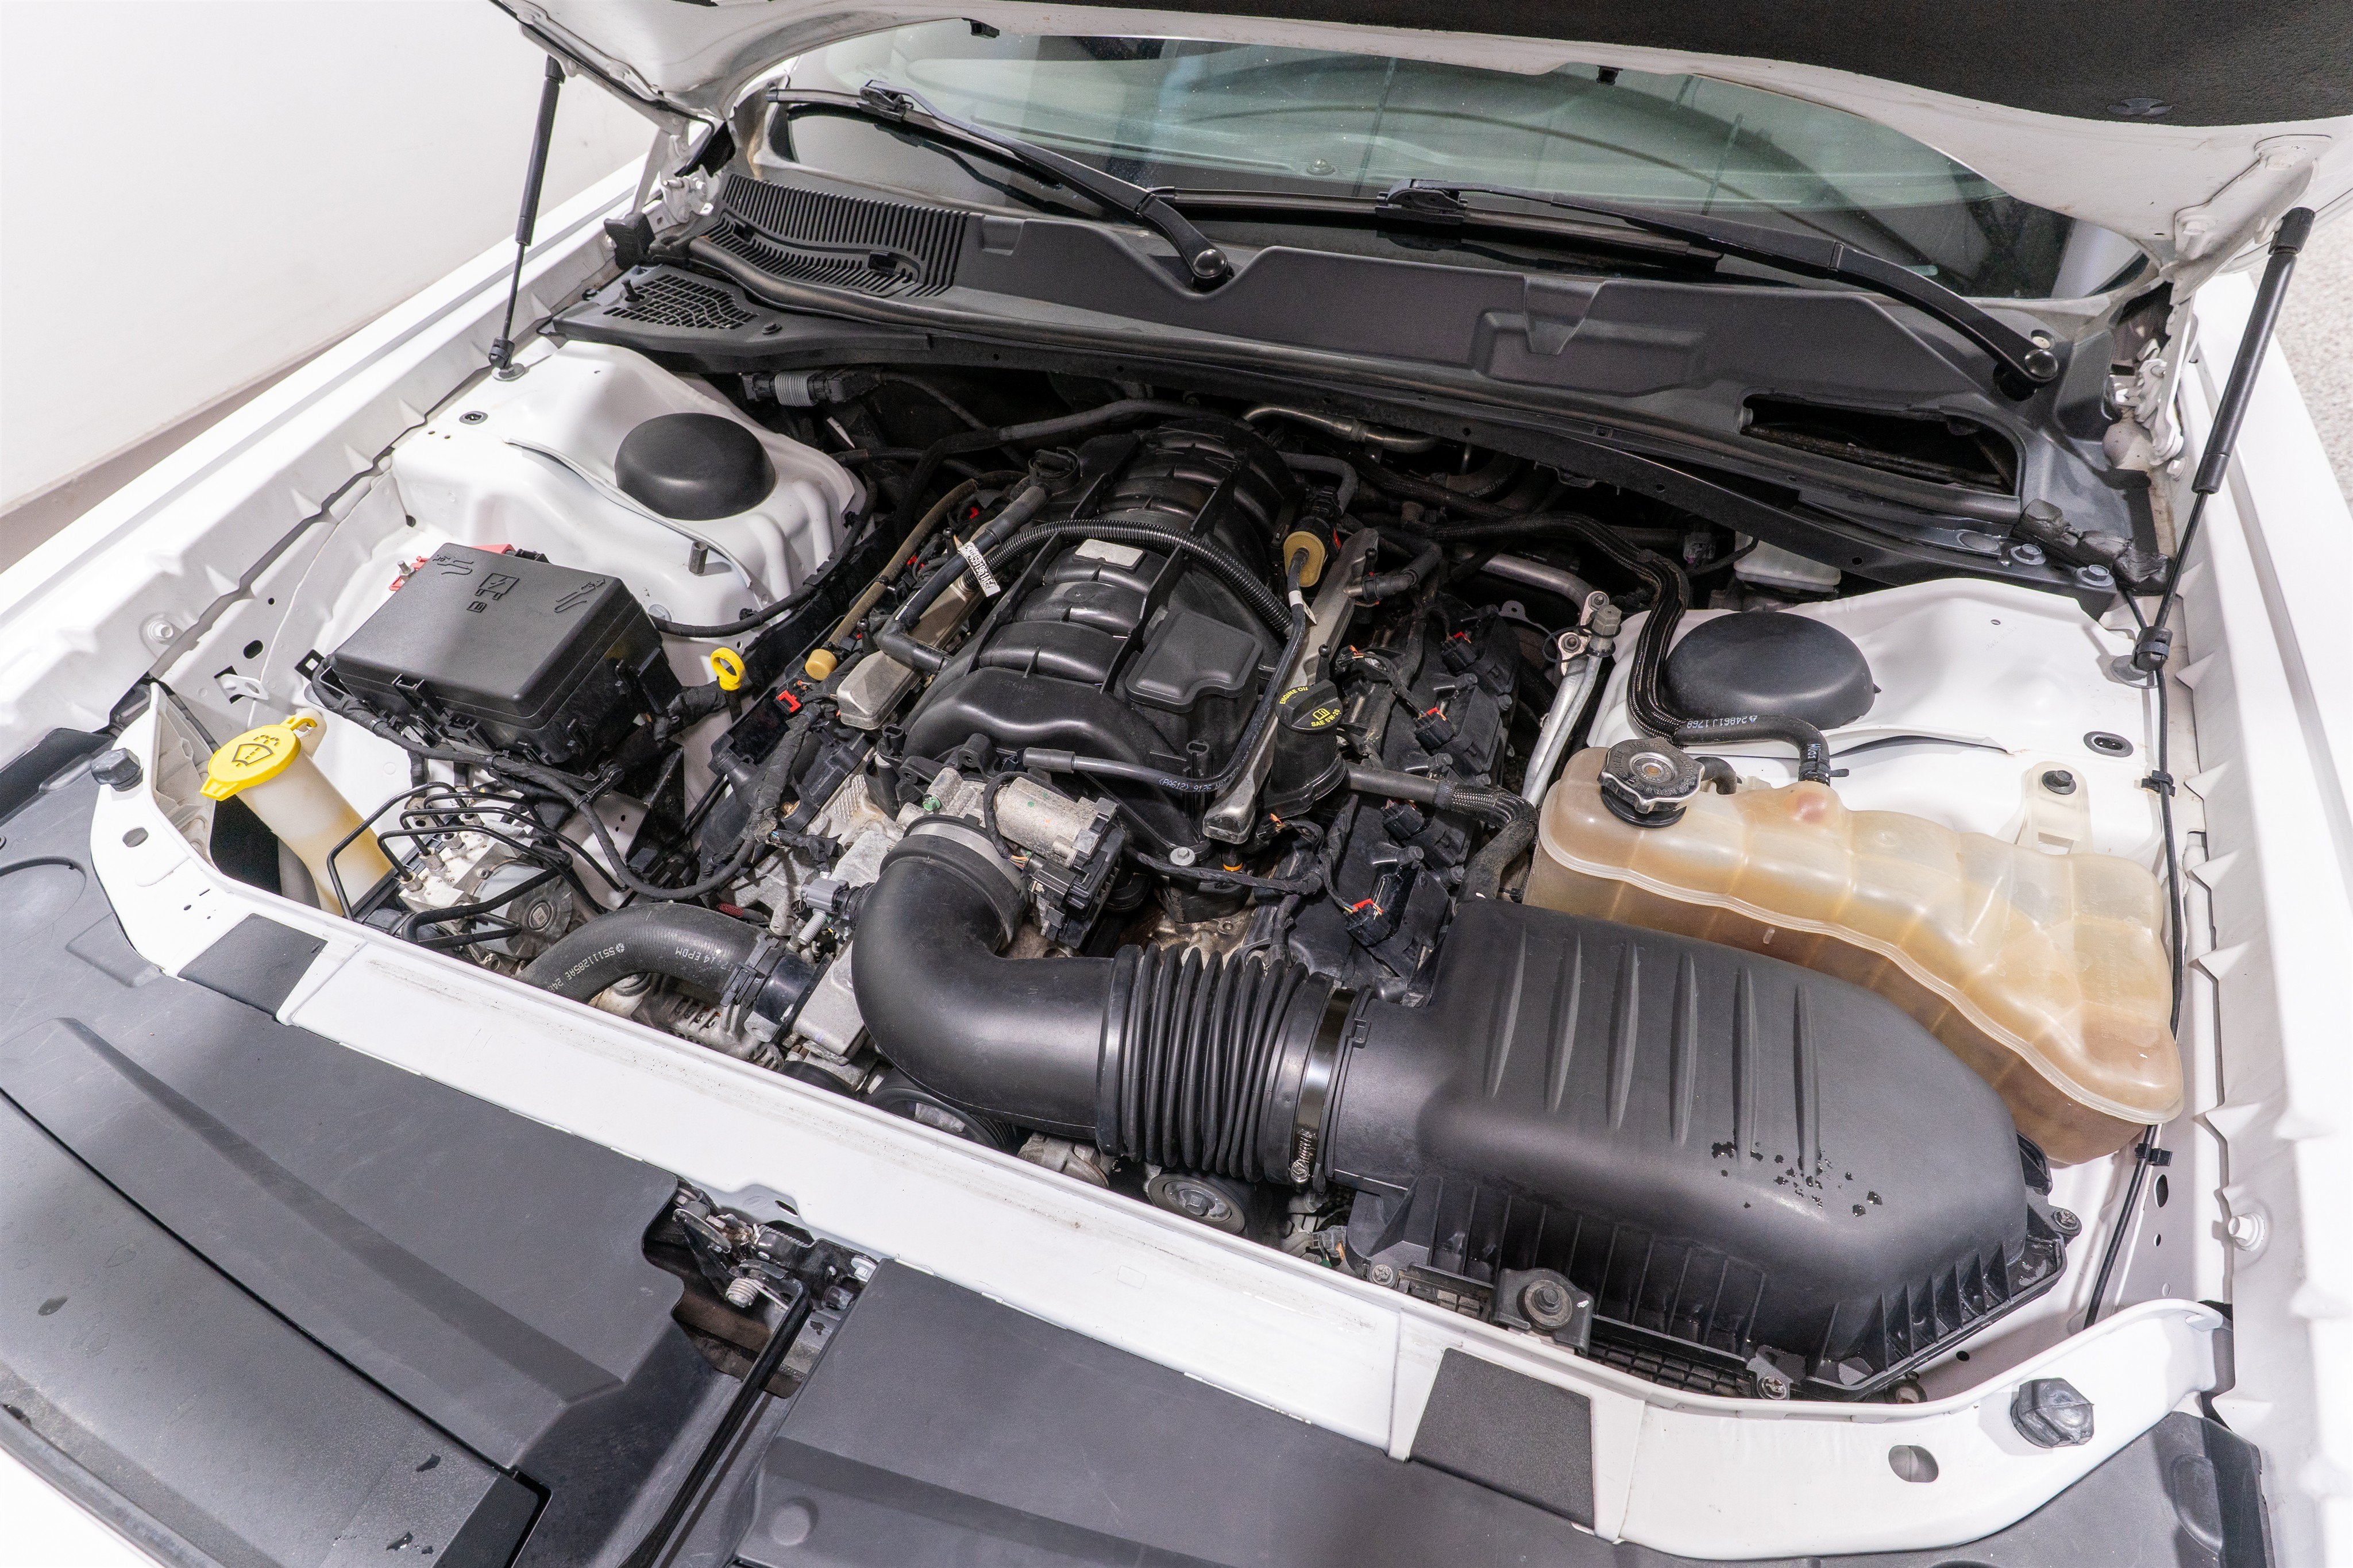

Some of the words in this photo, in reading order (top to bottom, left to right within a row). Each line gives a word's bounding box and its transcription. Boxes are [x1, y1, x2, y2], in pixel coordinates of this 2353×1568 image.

[1279, 689, 1298, 705] ENGINE
[1325, 709, 1341, 723] 5W-20
[1686, 719, 1710, 729] 1768
[1193, 784, 1212, 792] 9126
[1635, 783, 1653, 794] DO
[1653, 787, 1677, 797] NOT
[674, 946, 701, 960] EPDM
[564, 946, 616, 980] 55111285AE
